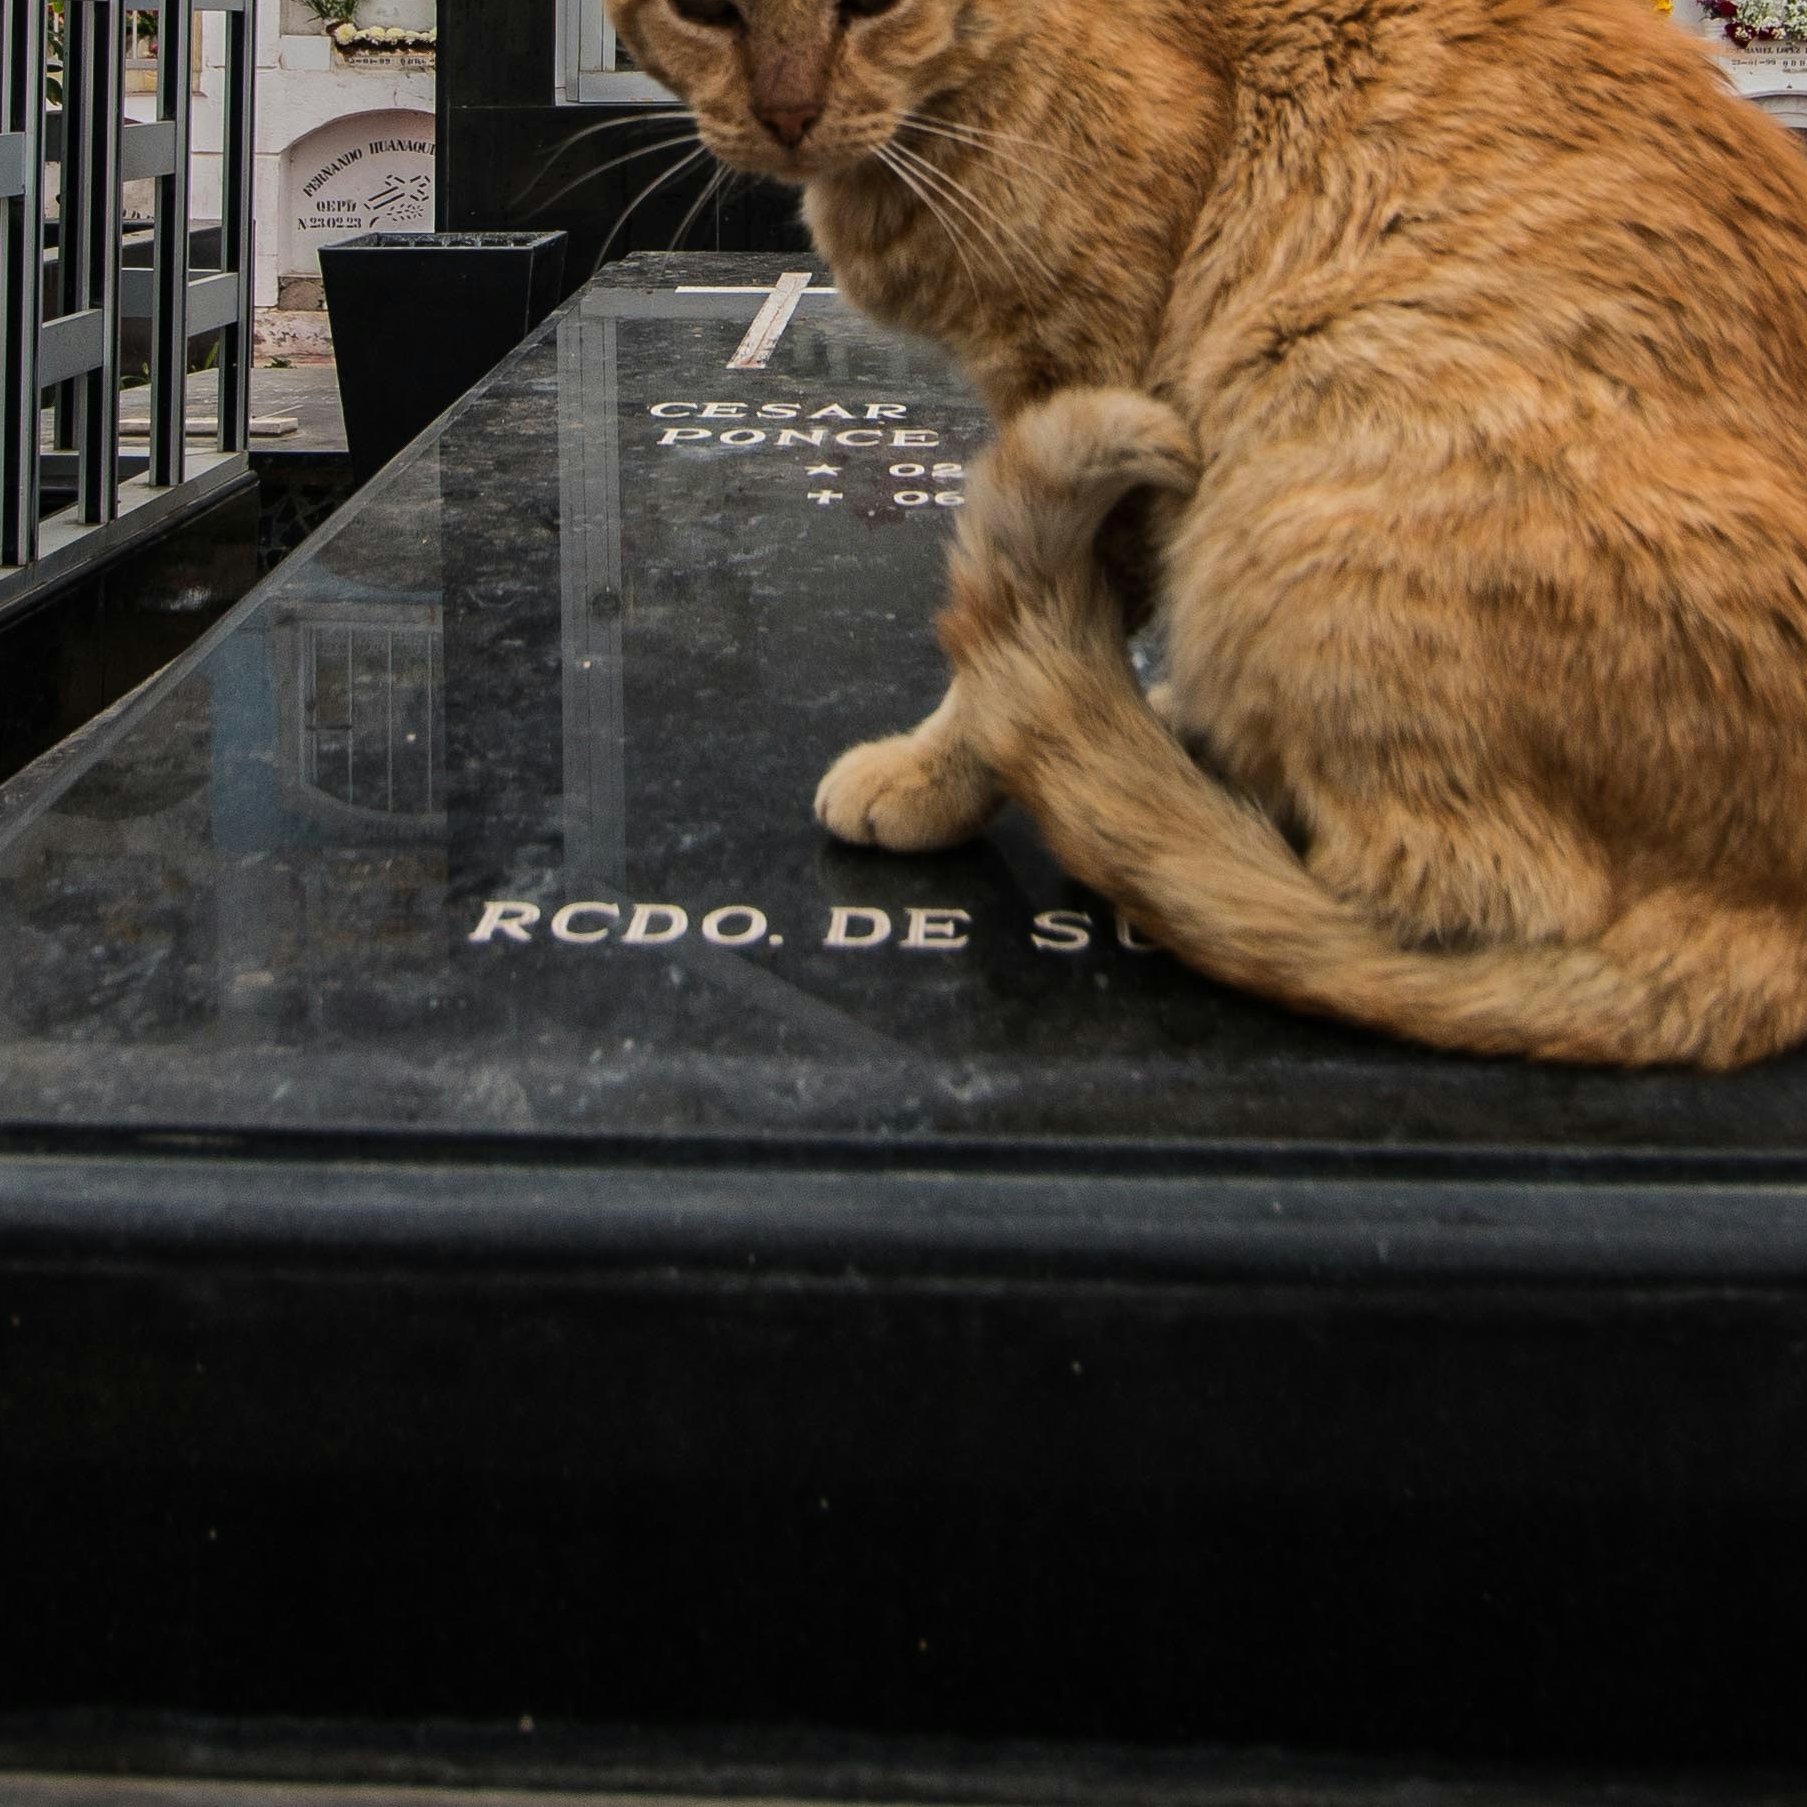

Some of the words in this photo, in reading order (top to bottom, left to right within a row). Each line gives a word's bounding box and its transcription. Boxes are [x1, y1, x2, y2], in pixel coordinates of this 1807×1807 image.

[303, 148, 363, 199] FERNANDO
[649, 402, 908, 421] CESAR
[656, 428, 941, 448] PONCE
[893, 491, 966, 507] 06
[467, 899, 784, 947] RCDO.
[823, 905, 973, 950] DE
